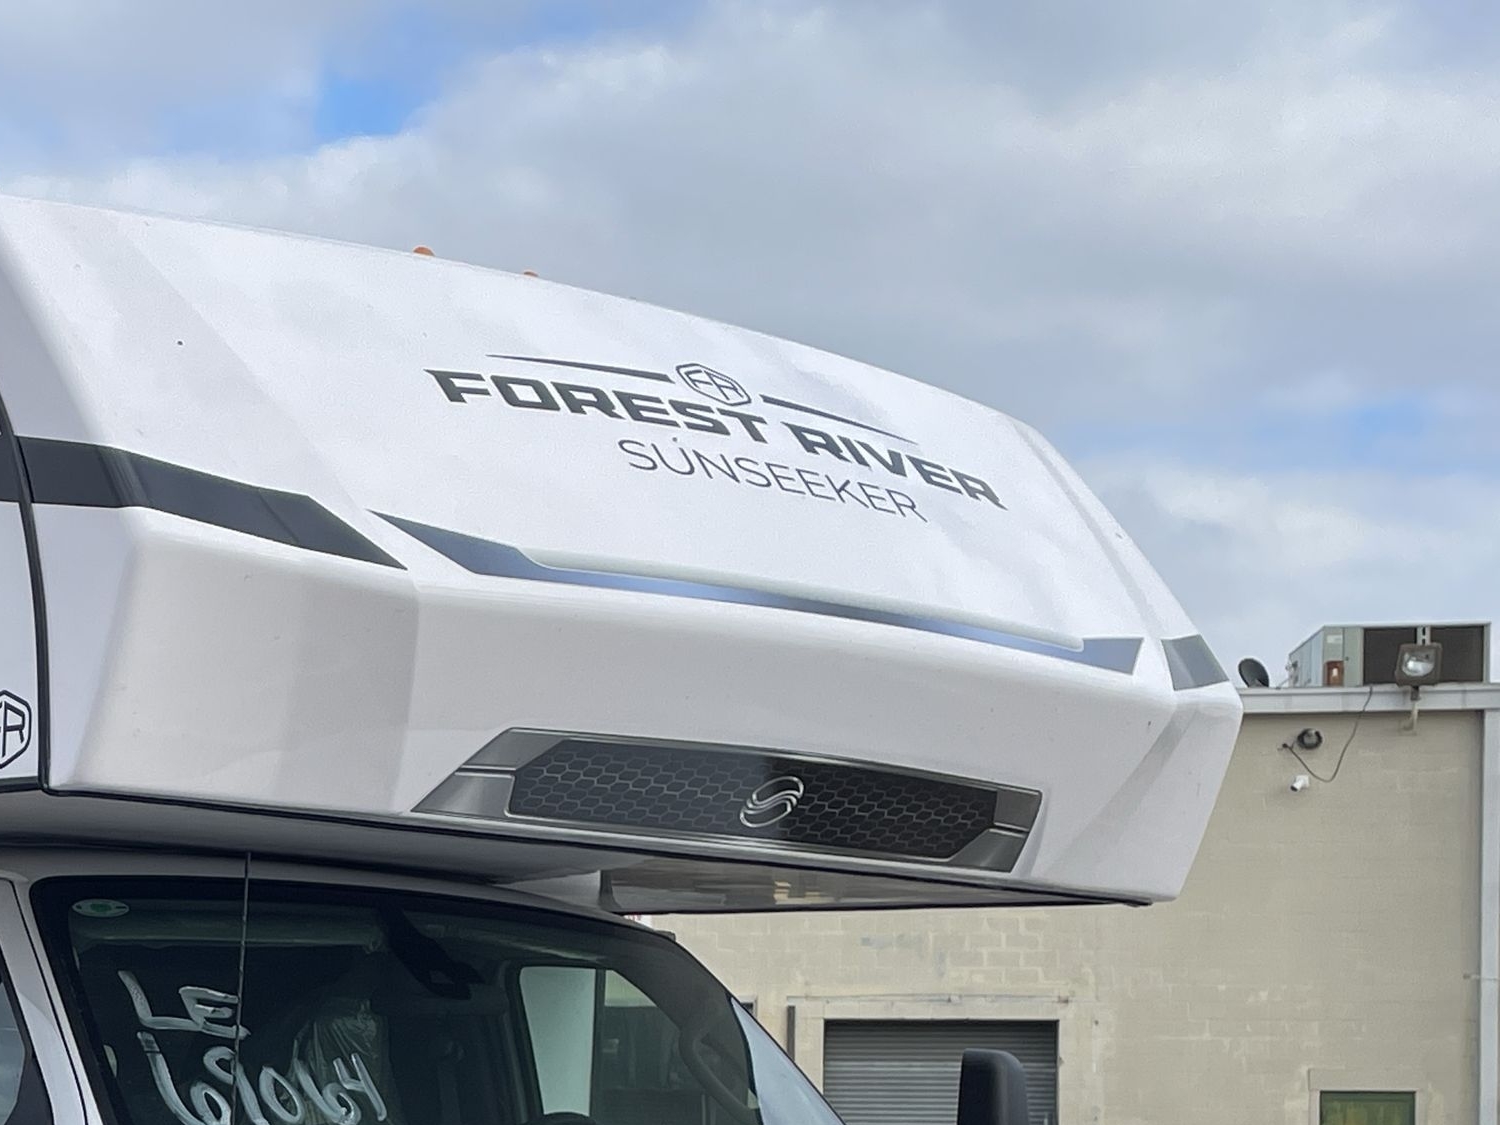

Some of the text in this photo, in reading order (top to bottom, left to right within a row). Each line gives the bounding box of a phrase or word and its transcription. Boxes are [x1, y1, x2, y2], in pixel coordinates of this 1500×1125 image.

[424, 368, 1010, 511] FOREST RIVER
[617, 438, 929, 524] SUNSEEKER
[117, 969, 251, 1040] LE
